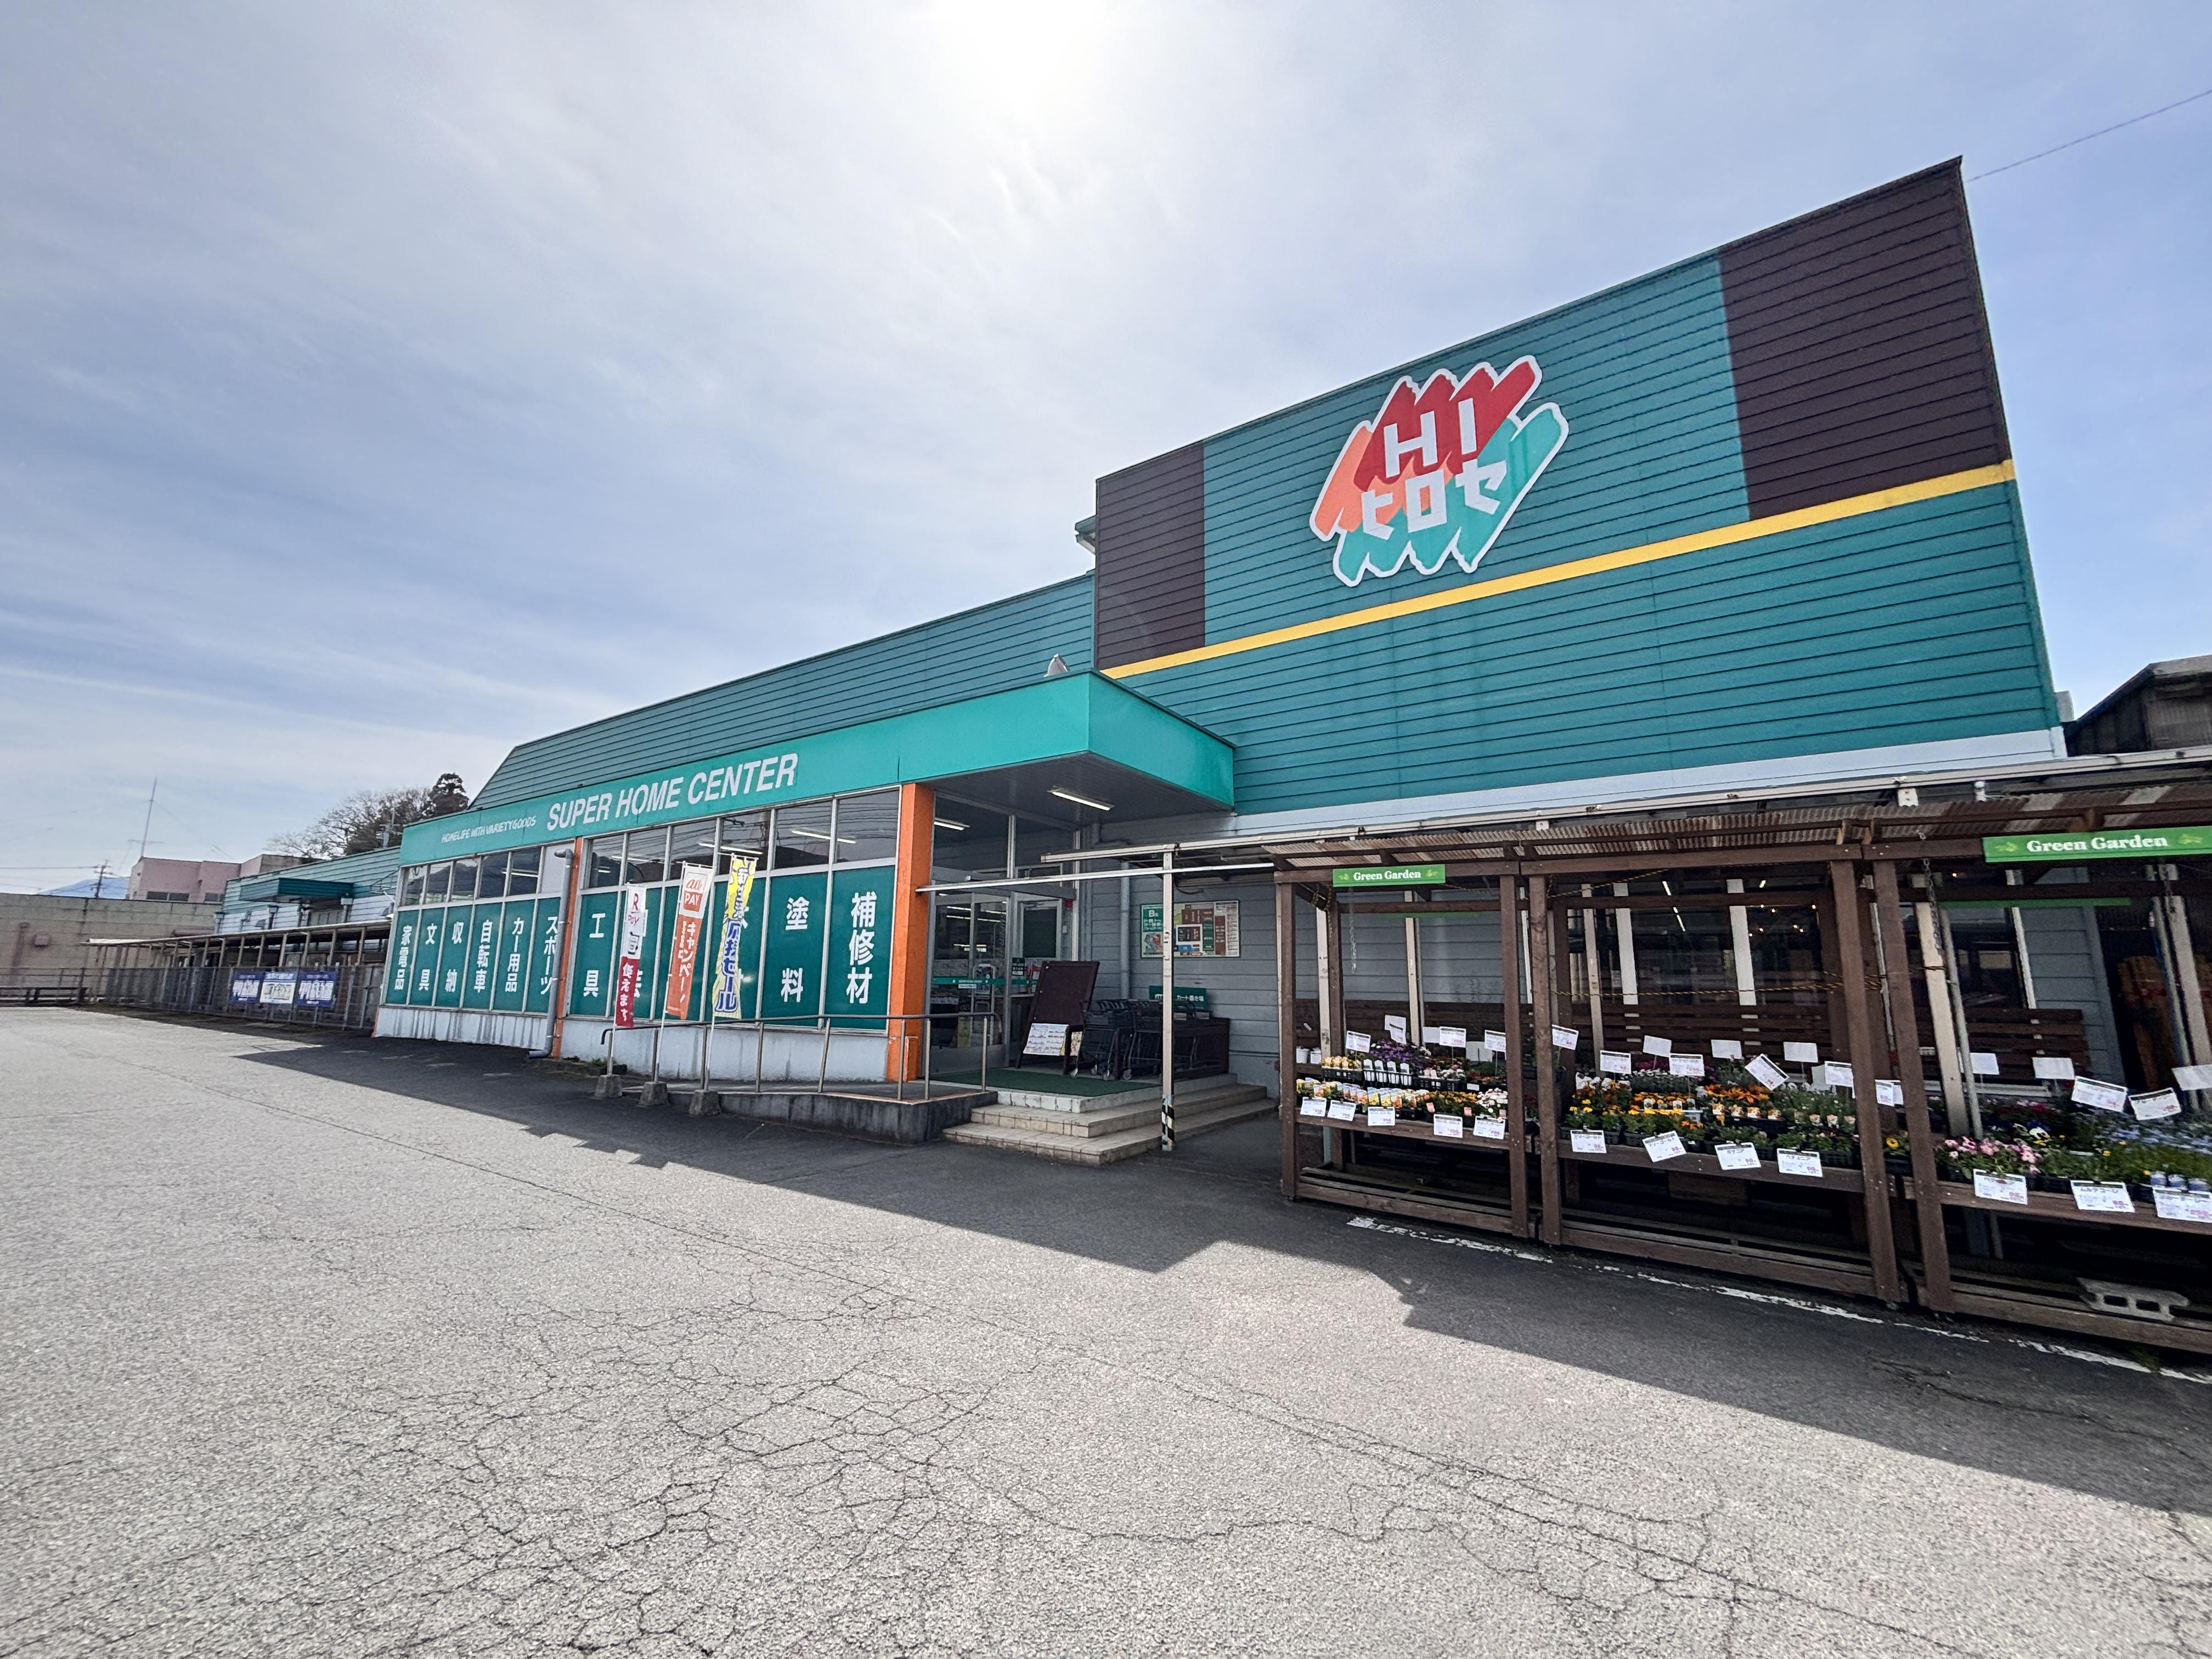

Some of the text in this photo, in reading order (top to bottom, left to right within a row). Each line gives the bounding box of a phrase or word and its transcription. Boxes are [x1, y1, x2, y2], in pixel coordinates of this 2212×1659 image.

[1384, 398, 1477, 477] HI
[1361, 459, 1508, 540] ヒロセ
[546, 753, 798, 831] SUPER HOME CENTER
[1353, 870, 1421, 881] Green Garden
[2027, 835, 2168, 853] Green Garden
[684, 893, 700, 906] PAY
[394, 926, 413, 991] 家電品
[419, 923, 438, 991] 文具
[445, 921, 464, 992] 収納
[473, 919, 493, 993] 自転車
[505, 917, 524, 992] カー用品
[540, 916, 558, 995] スポーツ
[583, 913, 606, 997] 工具
[781, 896, 810, 1002] 塗料
[846, 891, 877, 1004] 補修材
[620, 962, 634, 1022] 使えます
